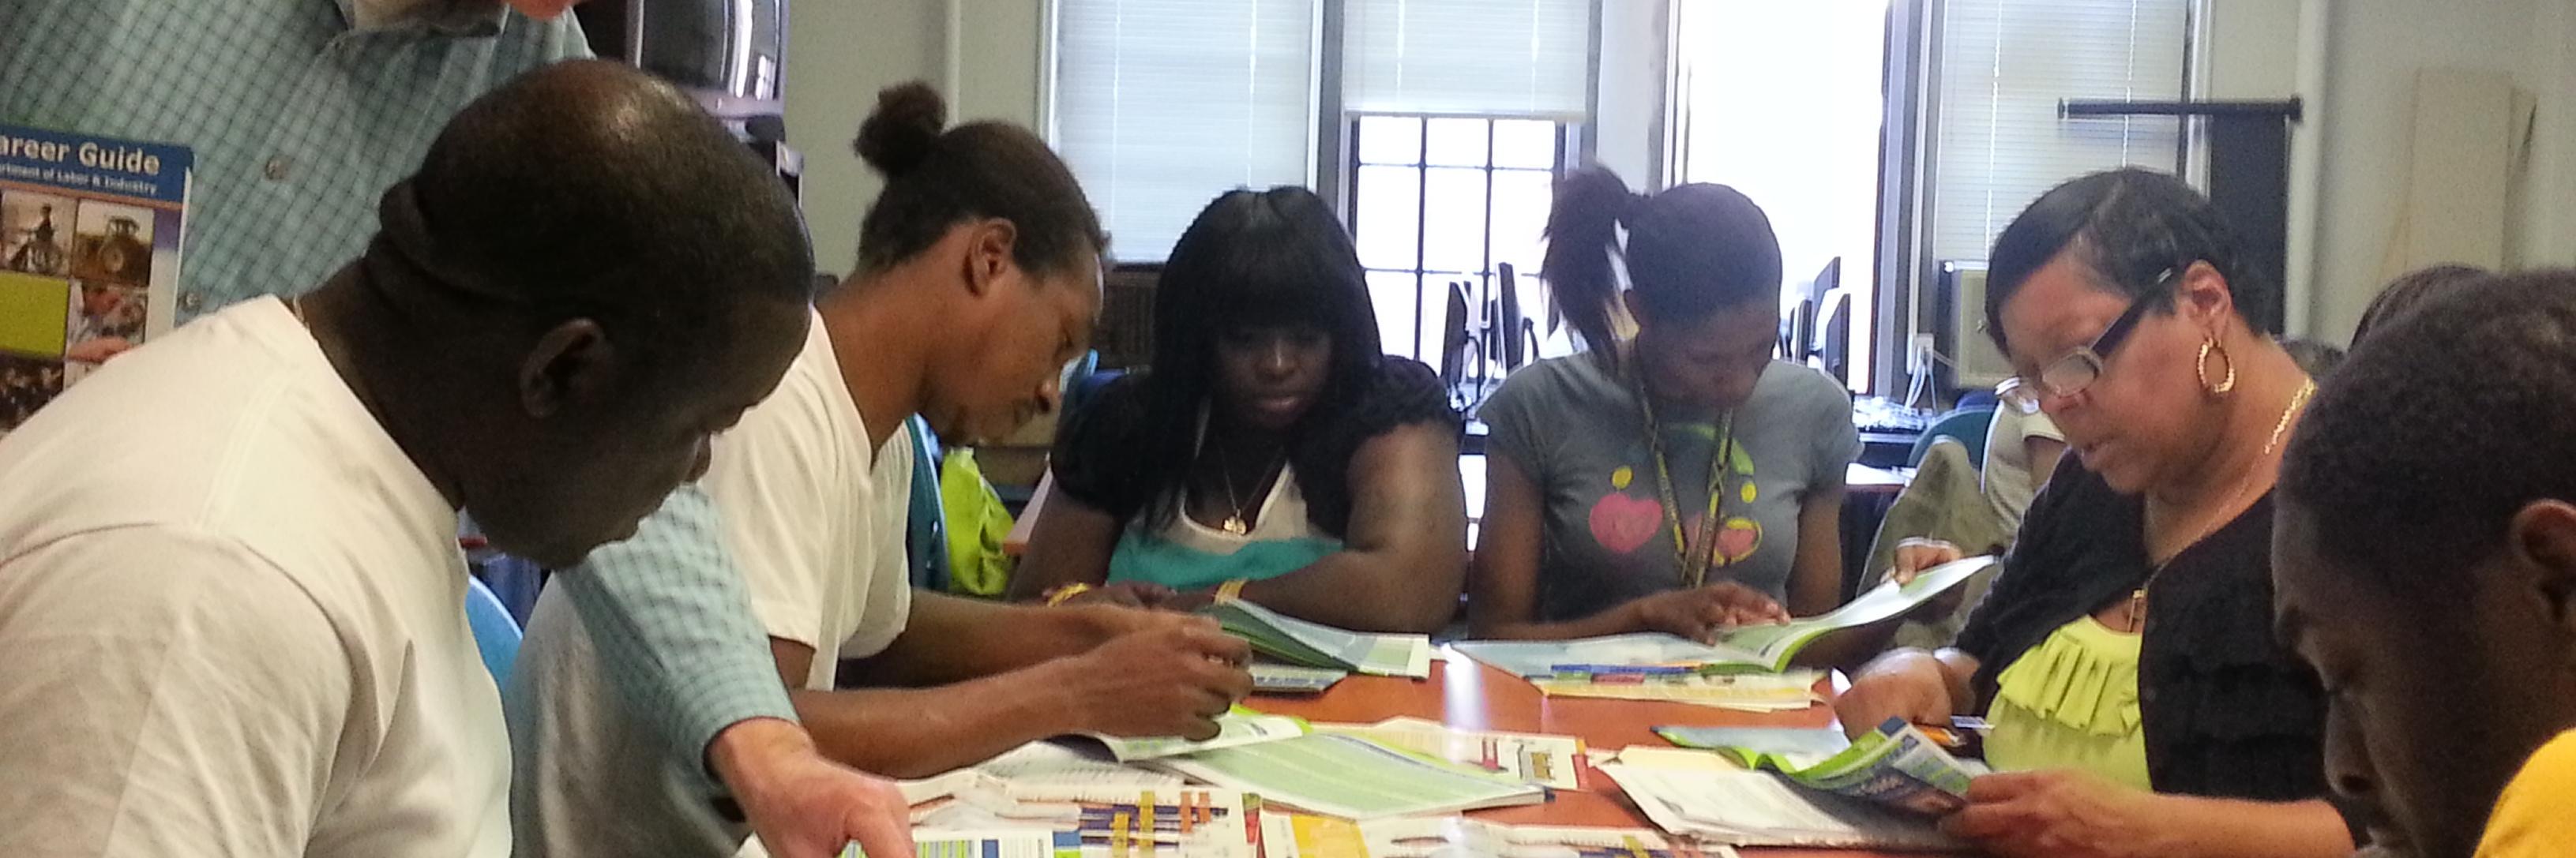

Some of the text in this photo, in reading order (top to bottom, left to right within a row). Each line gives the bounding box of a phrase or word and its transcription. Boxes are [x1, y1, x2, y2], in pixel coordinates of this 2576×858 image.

[79, 141, 160, 176] Guide
[43, 167, 54, 182] of
[58, 170, 88, 185] Labor
[105, 175, 157, 195] Industry
